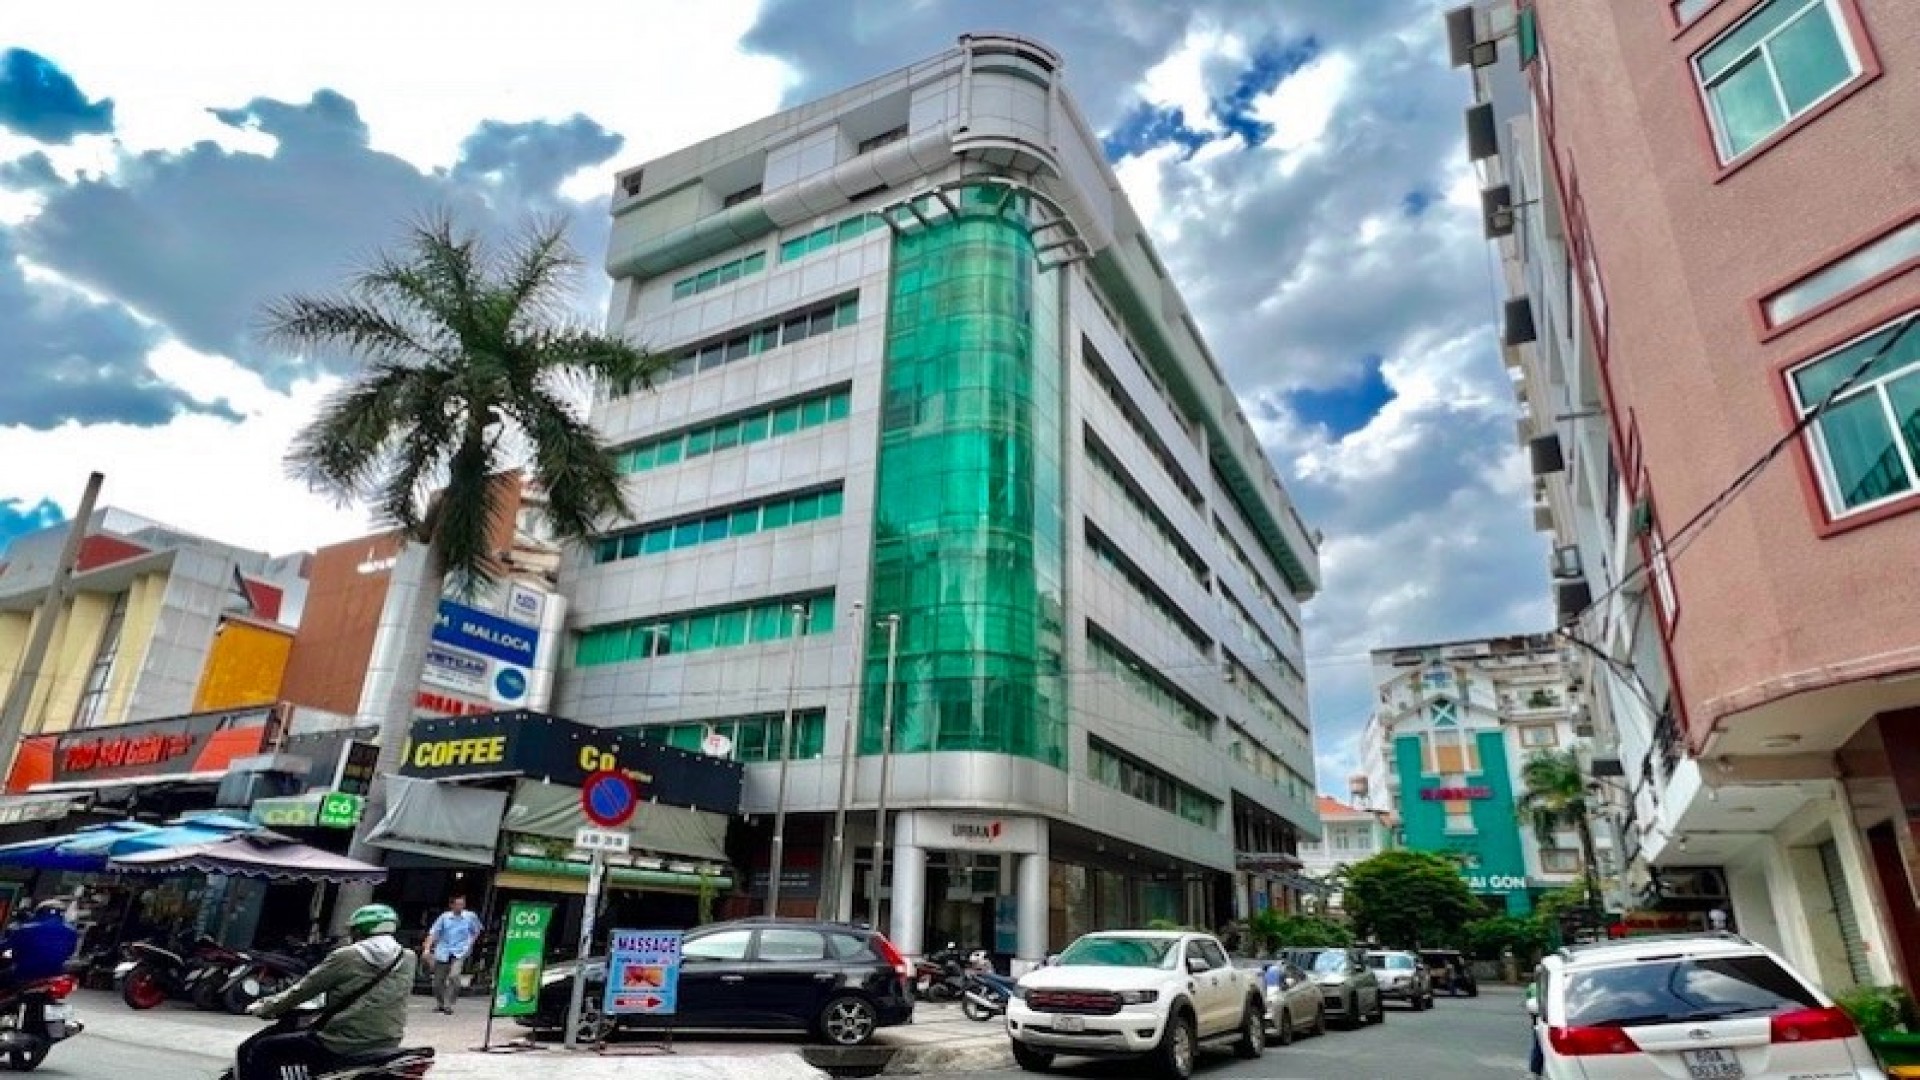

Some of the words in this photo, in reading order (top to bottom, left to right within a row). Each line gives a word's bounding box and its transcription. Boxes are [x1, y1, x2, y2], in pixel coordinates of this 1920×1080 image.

[462, 621, 531, 652] MALLOCA
[414, 736, 507, 768] COFFEE
[618, 936, 677, 953] MASSAGE
